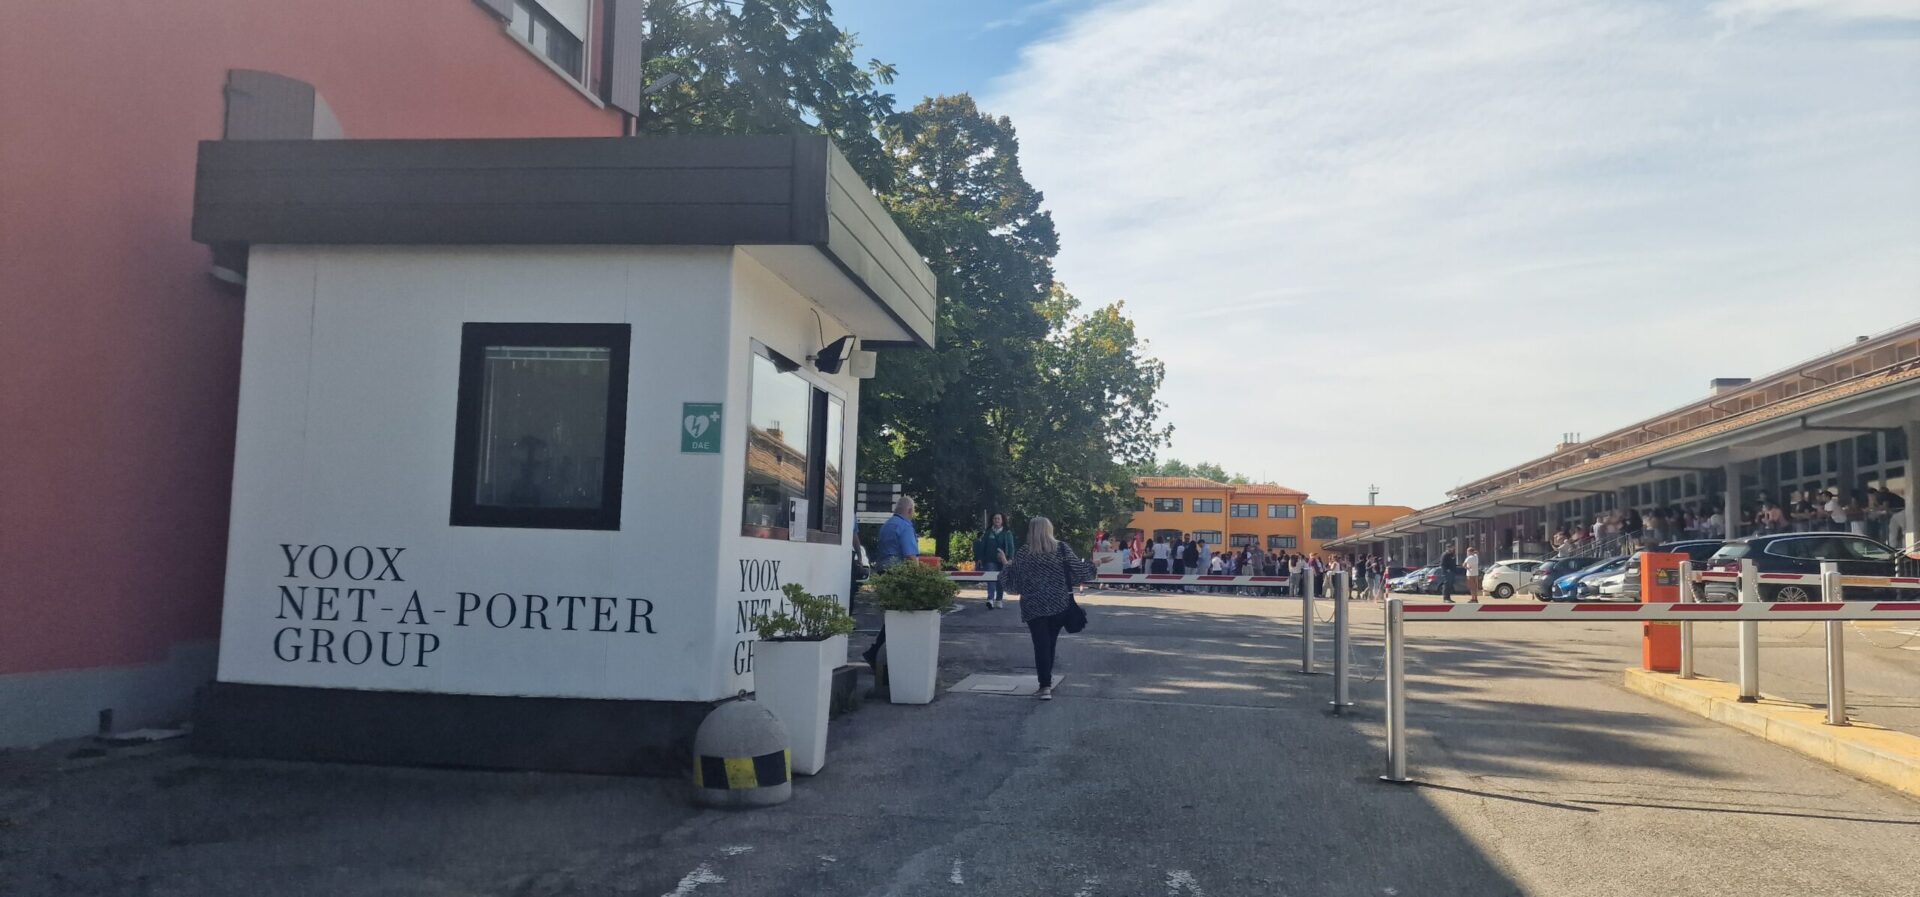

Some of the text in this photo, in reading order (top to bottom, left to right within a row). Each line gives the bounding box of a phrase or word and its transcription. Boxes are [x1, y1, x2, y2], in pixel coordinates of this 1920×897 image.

[692, 441, 710, 449] DAE
[279, 543, 407, 582] YOOX
[739, 558, 781, 592] YOOX
[274, 585, 658, 634] NET-A-PORTER
[273, 626, 441, 667] GROUP
